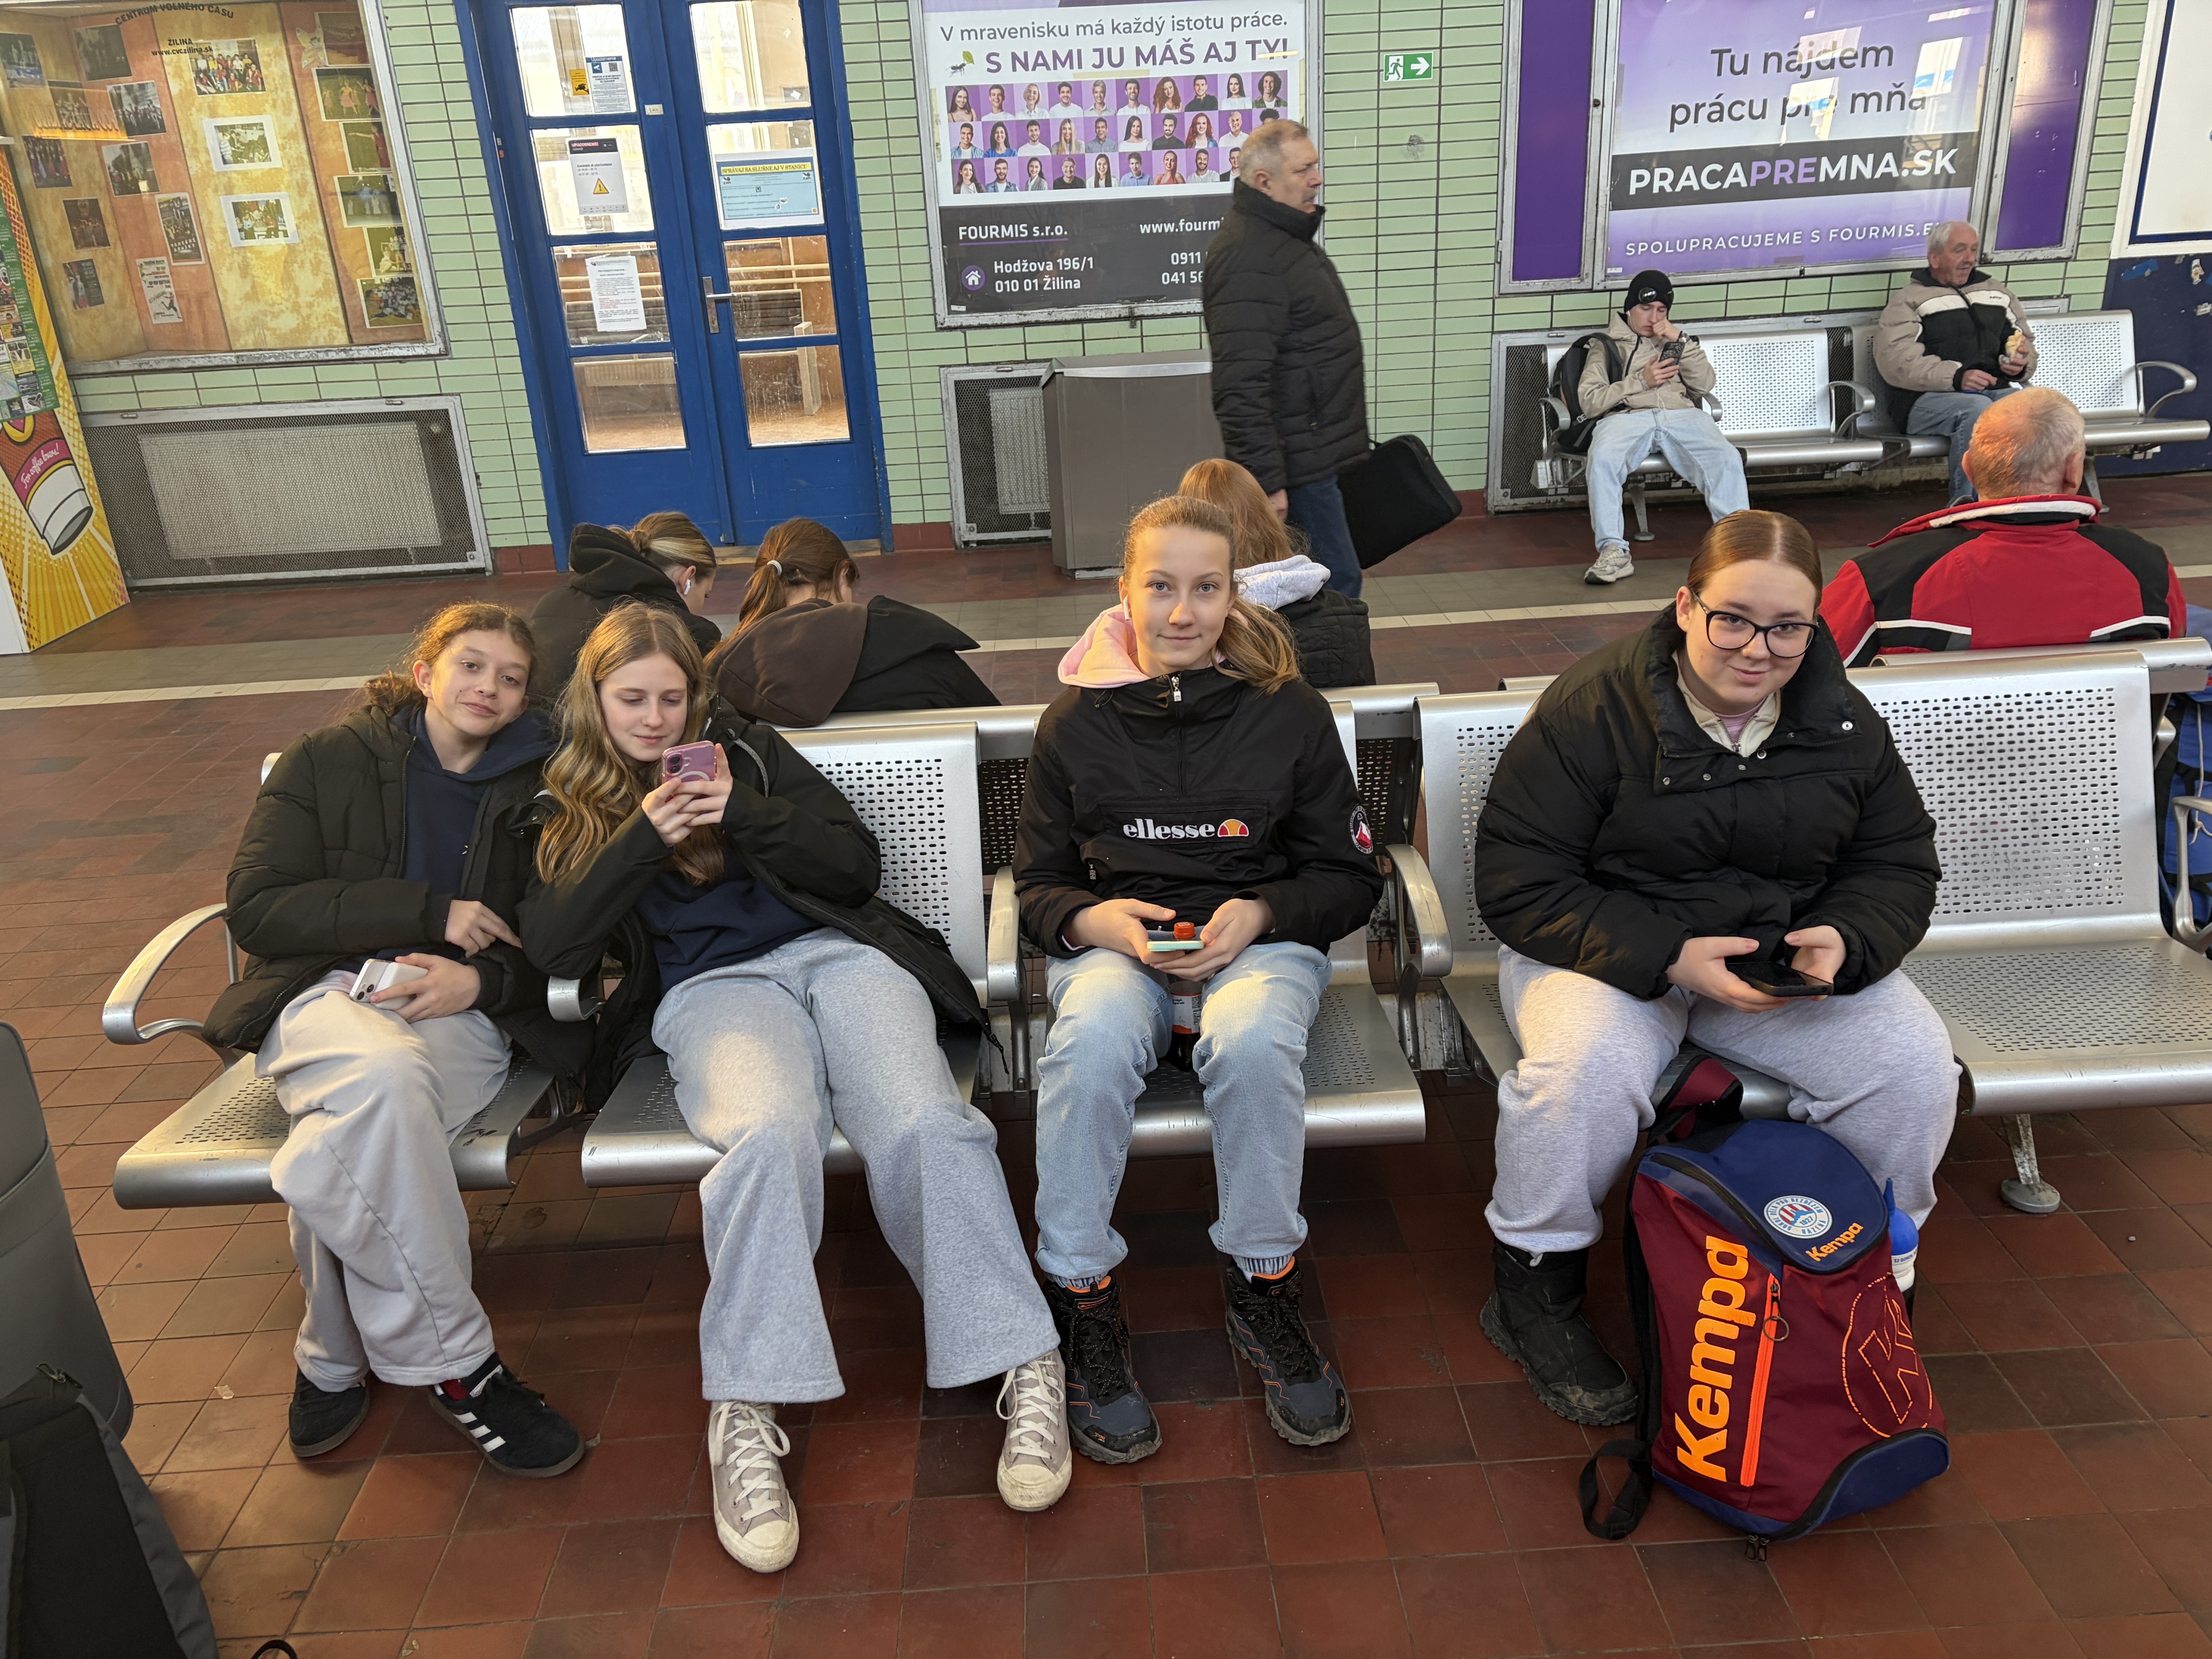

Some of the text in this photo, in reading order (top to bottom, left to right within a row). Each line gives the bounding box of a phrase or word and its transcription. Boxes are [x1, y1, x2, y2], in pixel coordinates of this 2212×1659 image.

[115, 5, 158, 25] CENTRUM
[941, 12, 1288, 42] V mravenisku má každý istotu práce.
[151, 46, 213, 56] www.cvczilina.sk
[168, 37, 193, 46] ŽILINA
[986, 38, 1288, 74] S NAMI JU MÁŠ AJ TY!
[1710, 42, 1894, 80] Tu nájdem
[1669, 92, 1768, 133] prácu
[1850, 81, 1927, 114] mňa
[1629, 148, 1959, 196] PRACAPREMNA.SK
[959, 223, 1068, 240] FOURMIS s.r.o.
[1140, 217, 1224, 234] www.fourm
[1626, 222, 1939, 256] SPOLUPRACUJEME S FOURMIS.E
[994, 256, 1094, 273] Hodžova 196/1
[1171, 251, 1201, 265] 0911
[995, 275, 1081, 293] 010 01 Žilina
[1162, 271, 1186, 285] 041
[21, 443, 60, 489] For coffee lovers!
[1123, 818, 1215, 839] ellesse
[1773, 1217, 1792, 1231] SOKOL
[1805, 1222, 1864, 1262] Kempa
[1675, 1235, 1756, 1482] Kempa
